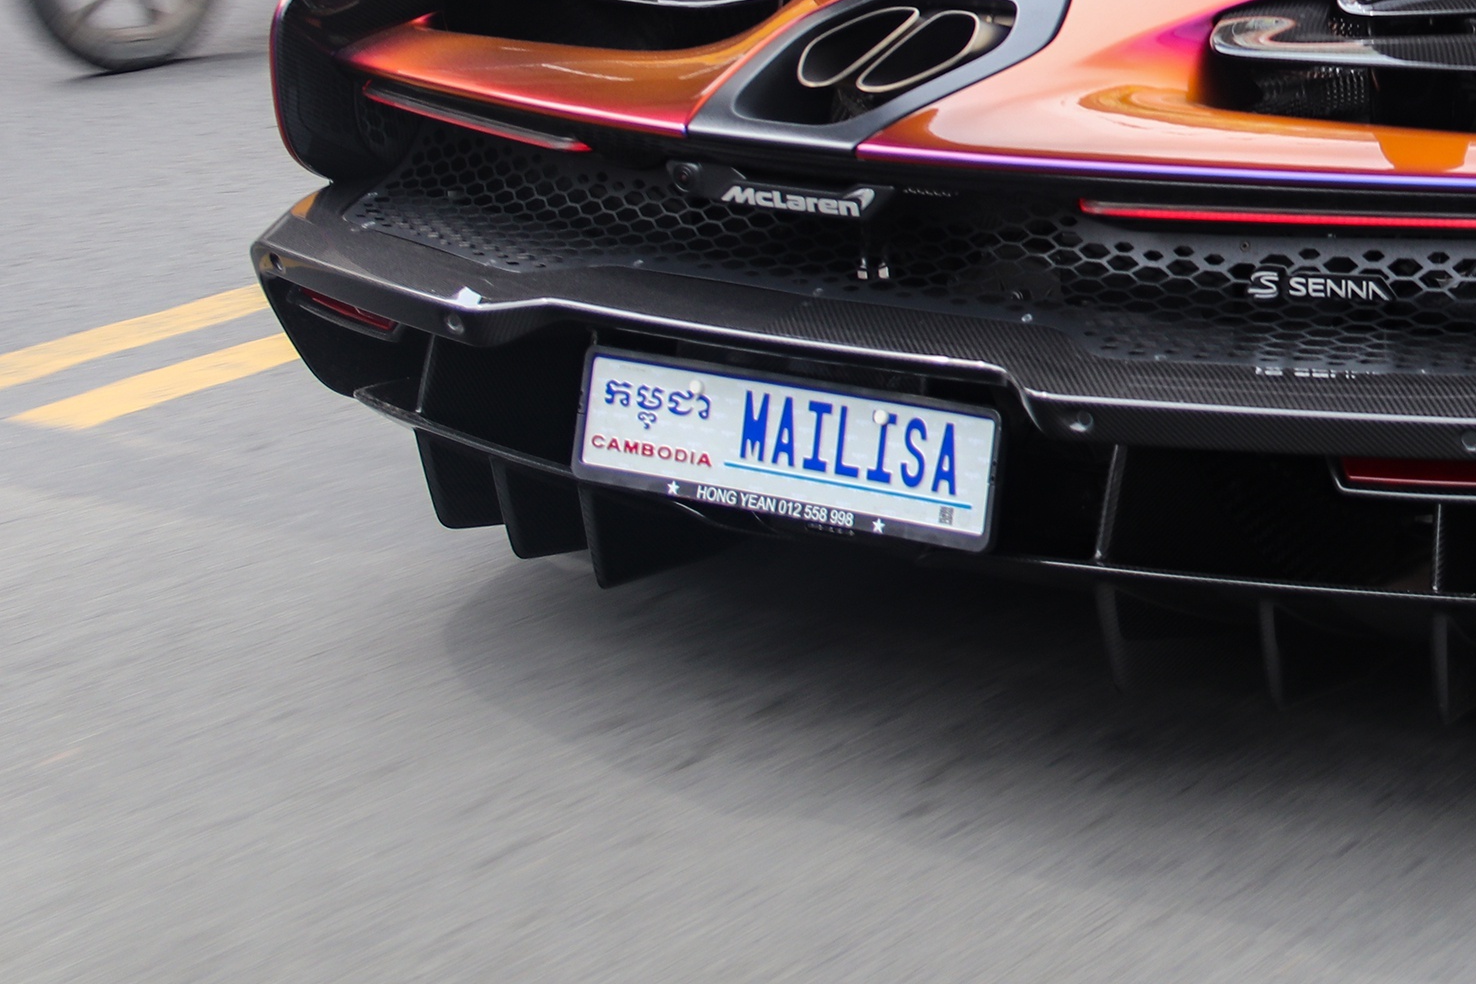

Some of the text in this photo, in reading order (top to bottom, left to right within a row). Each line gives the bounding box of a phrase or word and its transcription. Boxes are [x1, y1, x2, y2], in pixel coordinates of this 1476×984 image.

[721, 185, 861, 217] McLaren
[1288, 276, 1389, 301] SENNA
[591, 434, 713, 468] CAMBODIA
[739, 389, 958, 496] MAILISA
[696, 484, 855, 528] HONG YEAN 012 558 998
